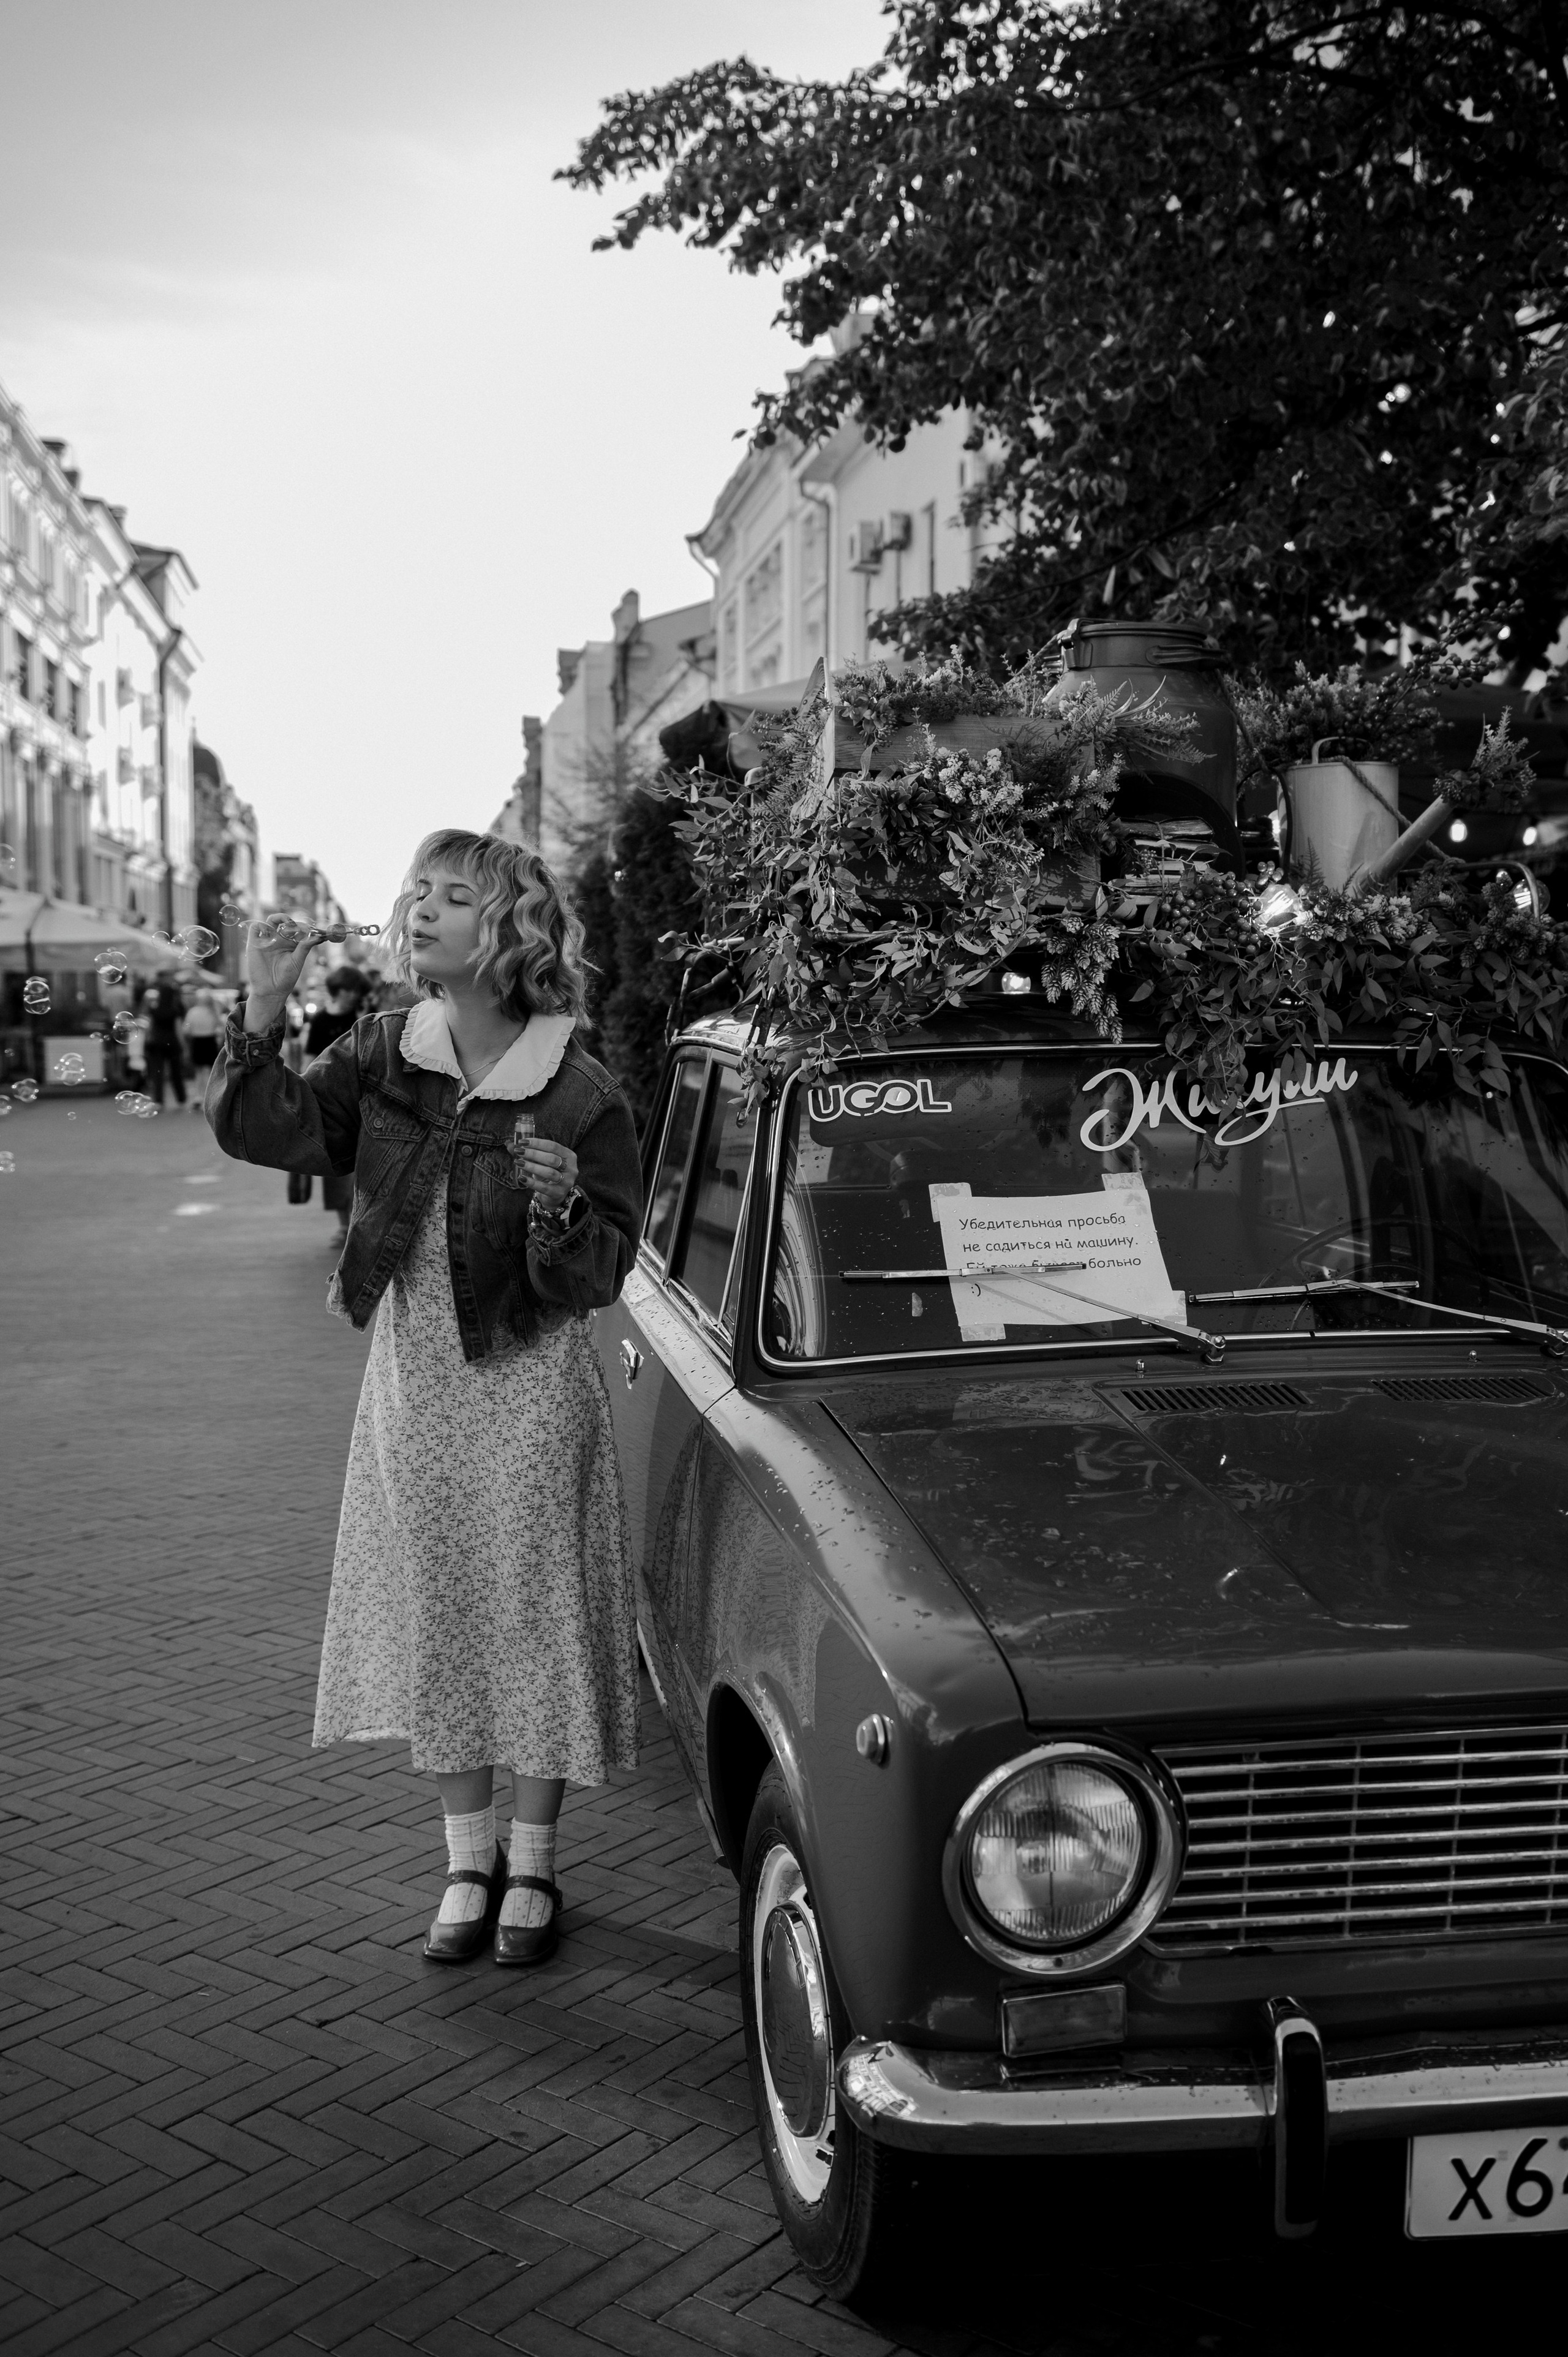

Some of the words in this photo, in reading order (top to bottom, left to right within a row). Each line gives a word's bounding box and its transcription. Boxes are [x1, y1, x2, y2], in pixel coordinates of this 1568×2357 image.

[808, 1079, 952, 1122] UGOL
[959, 1218, 1063, 1231] Убедительная
[1068, 1213, 1126, 1230] просьба
[963, 1243, 981, 1253] не
[986, 1240, 1051, 1252] садиться
[1055, 1239, 1072, 1250] на
[1077, 1237, 1138, 1248] машину.
[1088, 1258, 1141, 1269] больно
[1448, 2138, 1568, 2220] Х6
